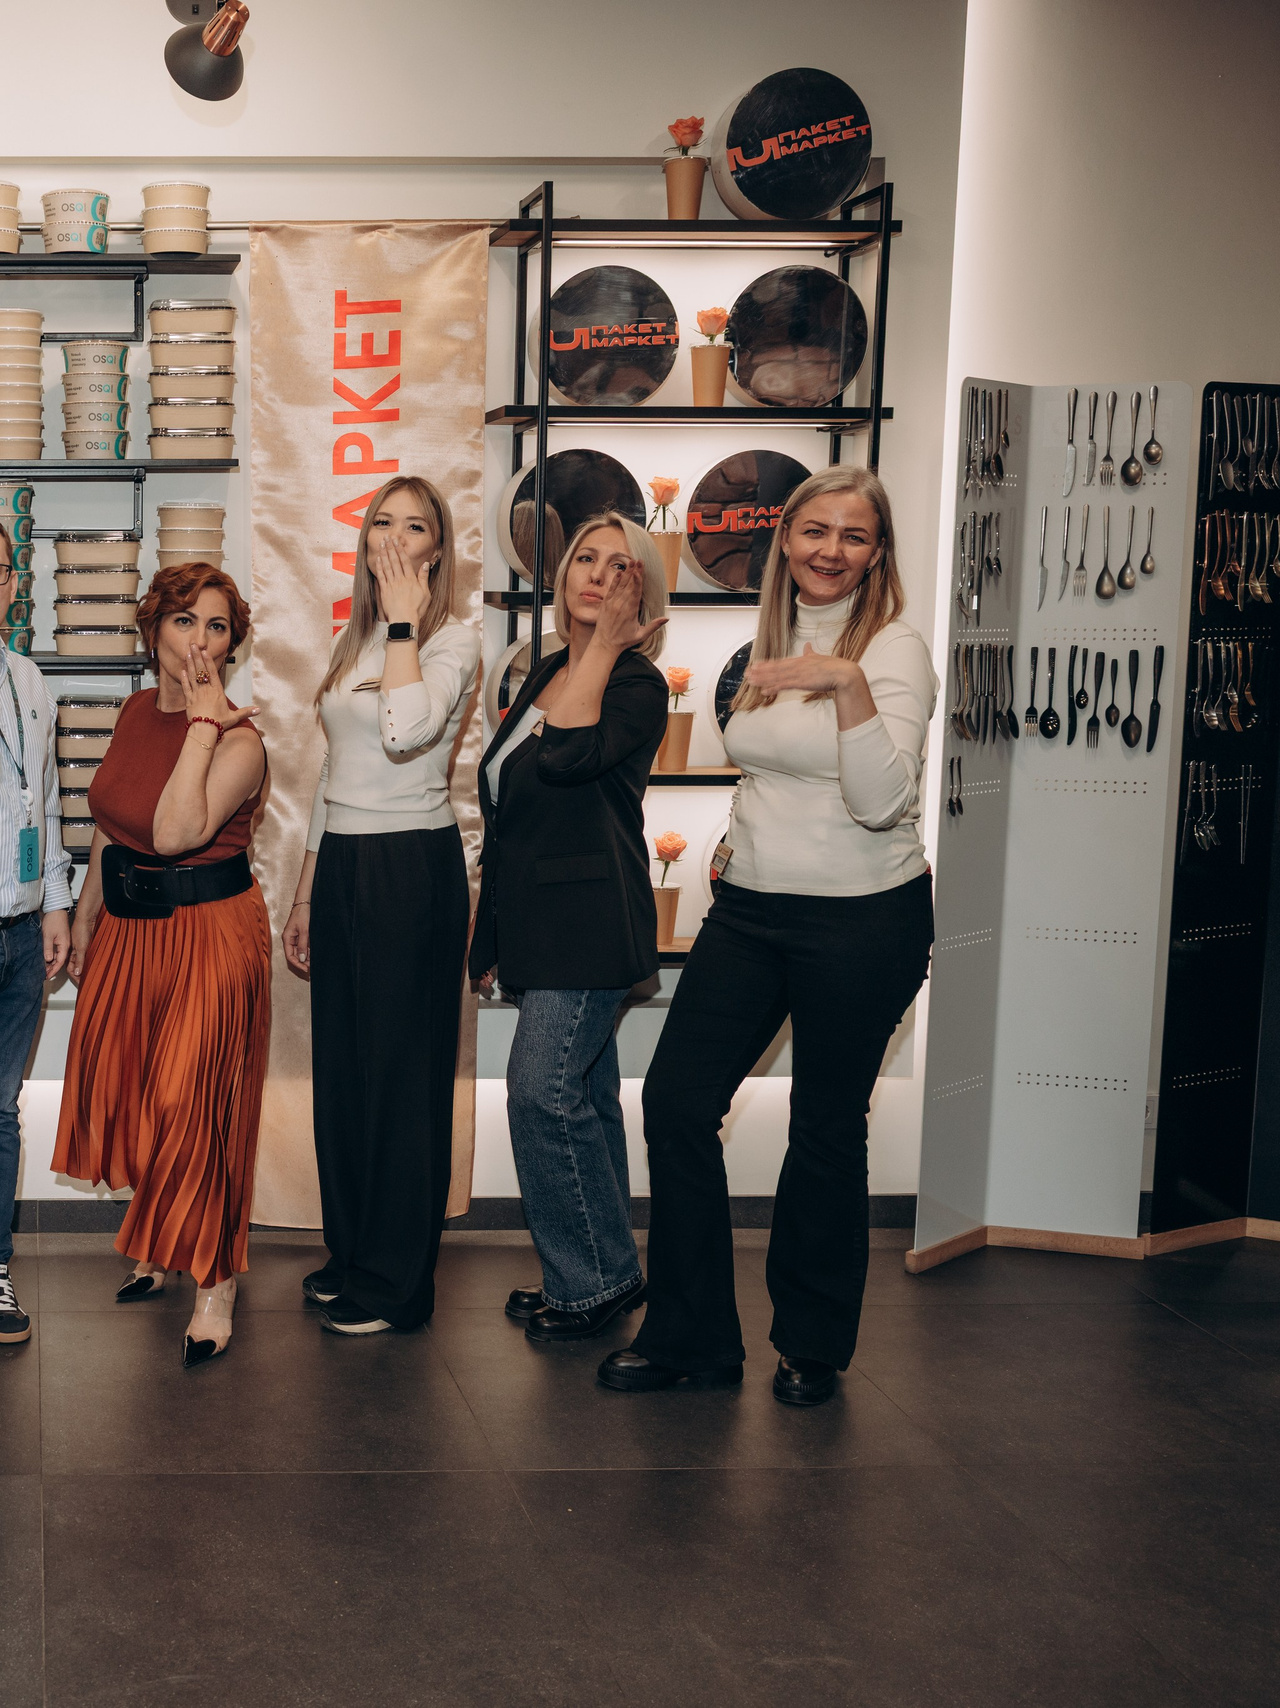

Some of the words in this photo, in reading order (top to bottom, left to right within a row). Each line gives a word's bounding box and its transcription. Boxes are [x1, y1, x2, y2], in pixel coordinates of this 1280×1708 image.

[778, 115, 854, 143] ПАКЕТ
[781, 124, 871, 156] МАРКЕТ
[57, 232, 79, 242] OSQ
[592, 322, 666, 335] ПАКЕТ
[592, 335, 679, 348] МАРКЕТ
[93, 354, 114, 364] OSQ
[89, 384, 111, 393] OSQ
[88, 412, 110, 421] OSQ
[85, 441, 108, 450] OSQ
[738, 505, 784, 517] ПАК
